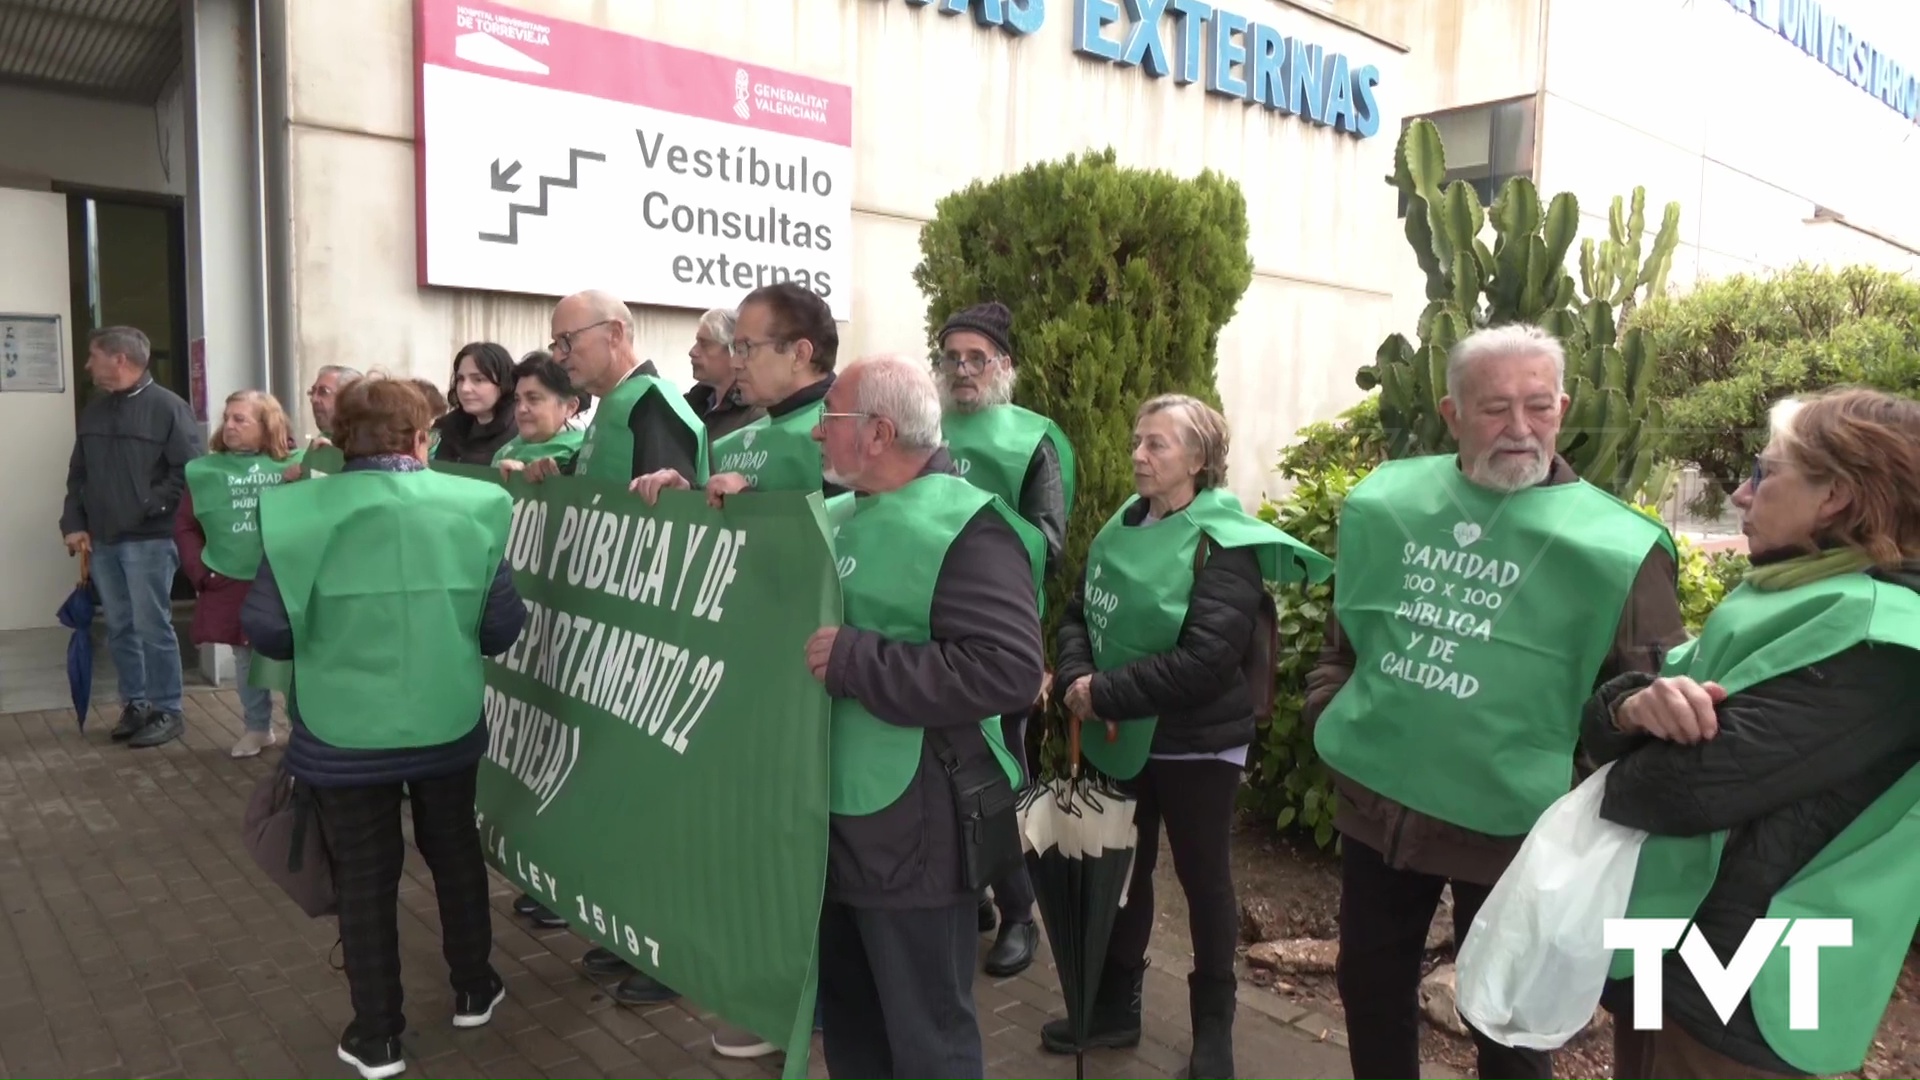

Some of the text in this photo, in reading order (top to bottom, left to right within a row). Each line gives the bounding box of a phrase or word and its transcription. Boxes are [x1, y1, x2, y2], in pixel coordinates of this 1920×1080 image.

[457, 5, 551, 34] HOSPITAL UNIVERSITARIO
[457, 13, 550, 46] DE TORREVIEJA
[1074, 0, 1380, 139] EXTERNAS
[754, 83, 829, 111] GENERALITAT
[755, 97, 827, 124] VALENCIANA
[635, 128, 832, 196] Vestíbulo
[642, 191, 832, 251] Consultas
[672, 253, 832, 297] externas
[228, 473, 282, 487] SANIDAD
[549, 494, 673, 606] PÚBLICA
[671, 523, 708, 611] Y
[692, 529, 746, 622] DE
[1402, 541, 1520, 588] SANIDAD
[1402, 573, 1436, 593] 100
[1460, 587, 1502, 610] 100
[1394, 596, 1493, 642] PÚBLICA
[1406, 631, 1460, 663] Y DE
[1380, 651, 1480, 700] CALIDAD
[661, 655, 724, 755] 22
[516, 851, 557, 902] LEY
